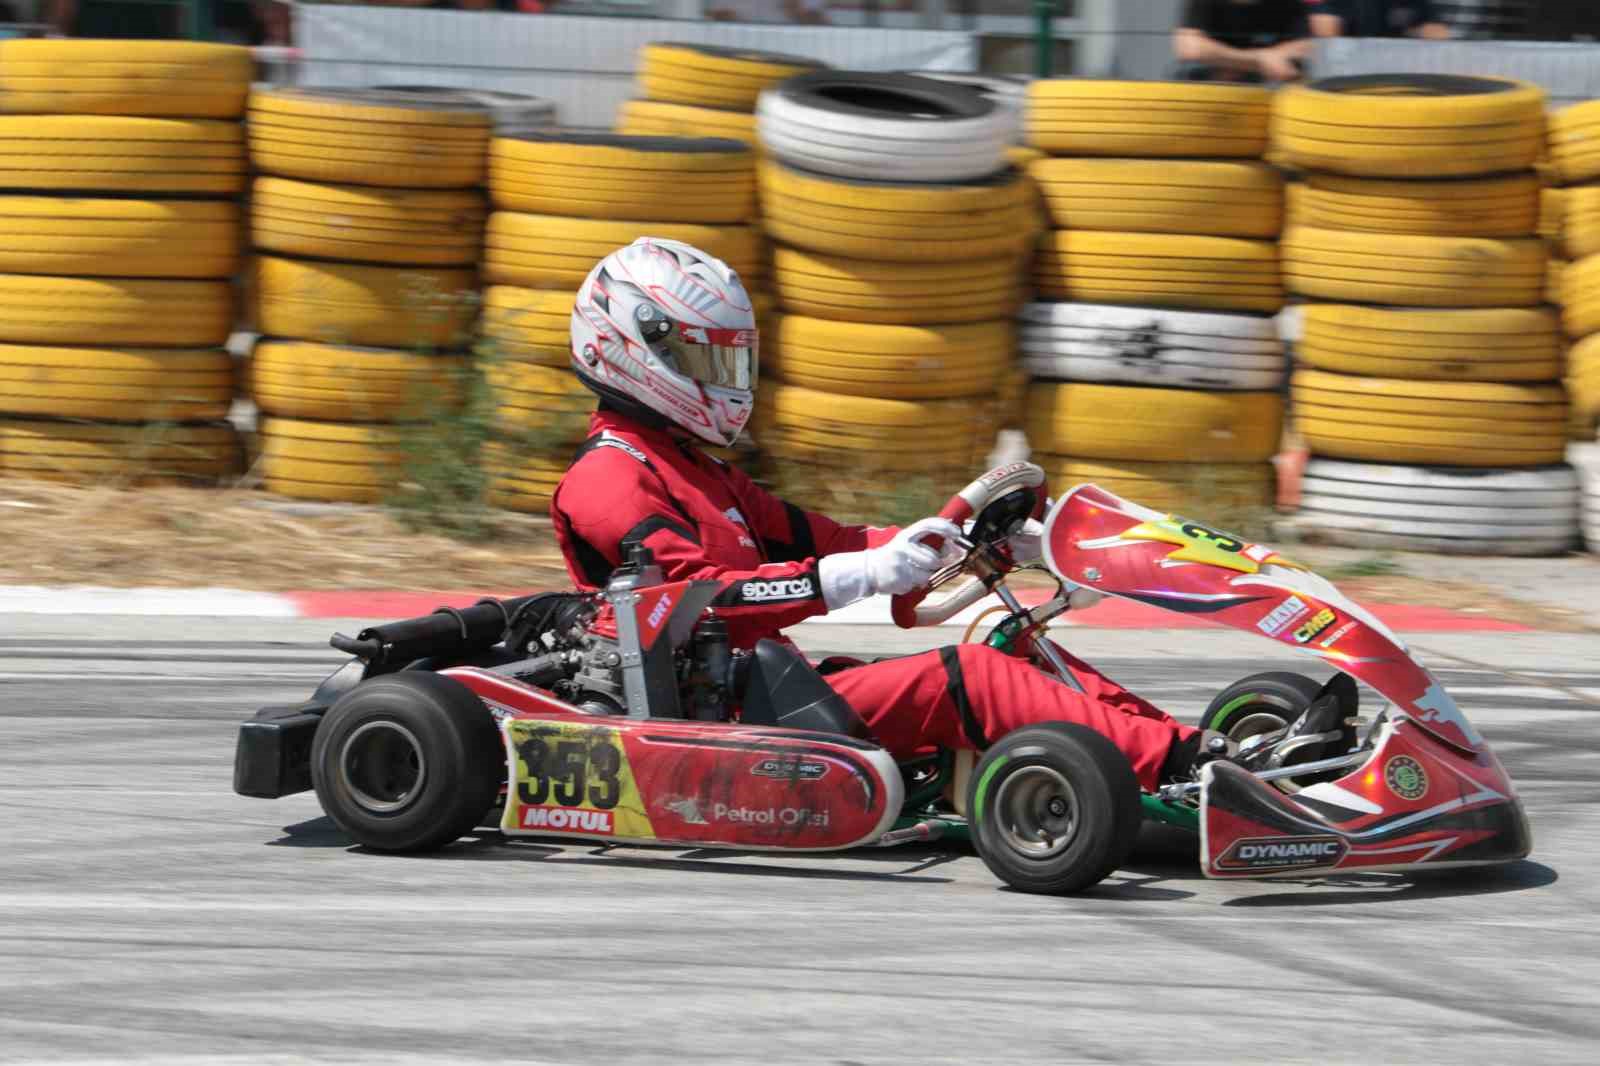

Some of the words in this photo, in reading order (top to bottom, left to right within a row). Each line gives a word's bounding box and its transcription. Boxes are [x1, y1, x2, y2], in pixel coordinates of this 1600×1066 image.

[1182, 524, 1243, 553] 3
[742, 578, 814, 601] sparco
[515, 738, 621, 809] 353
[524, 808, 612, 831] MOTUL
[714, 803, 775, 824] Petrol
[780, 808, 829, 826] Ofsi
[1239, 842, 1338, 859] DYNAMIC
